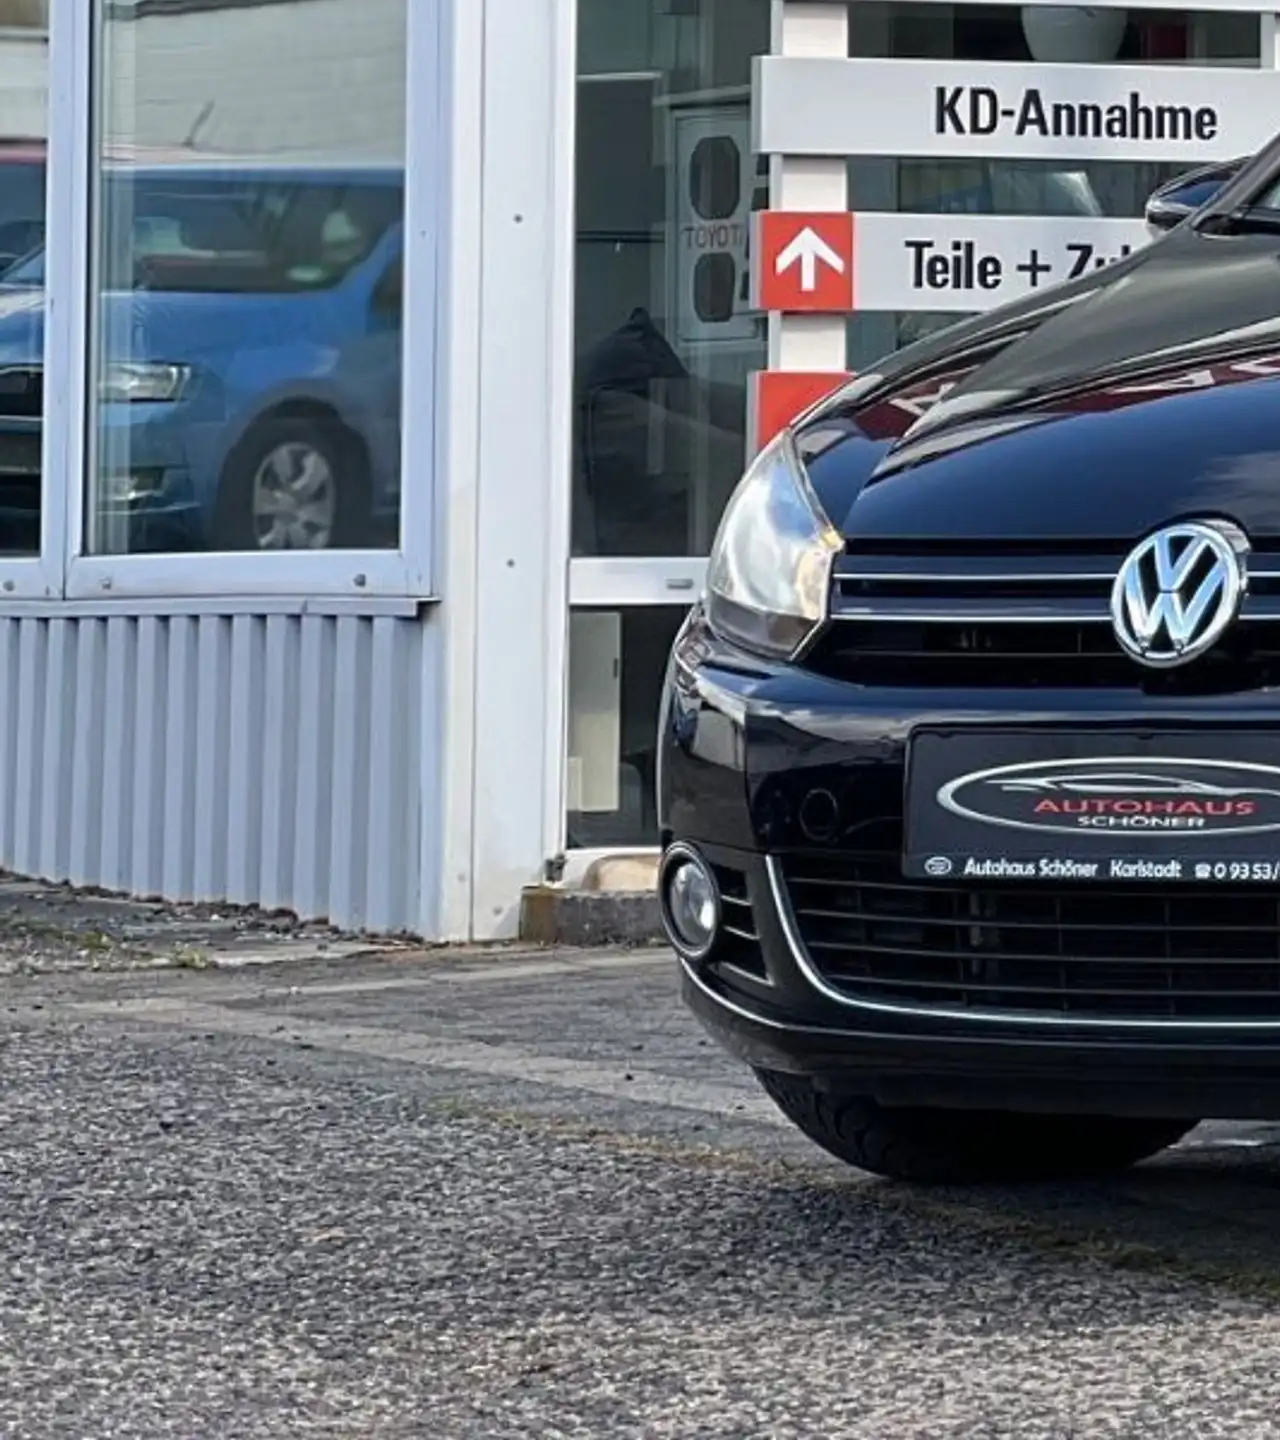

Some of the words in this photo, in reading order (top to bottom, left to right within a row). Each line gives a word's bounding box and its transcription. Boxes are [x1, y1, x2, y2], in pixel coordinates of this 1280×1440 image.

[934, 86, 1218, 140] KD-Annahme
[905, 240, 1002, 290] Teile
[1033, 798, 1255, 815] AUTOHAUS
[1077, 815, 1206, 828] SCHÖNER
[963, 856, 1036, 877] Autohaus
[1039, 857, 1099, 878] Schöner
[1110, 859, 1183, 879] Karlstadt
